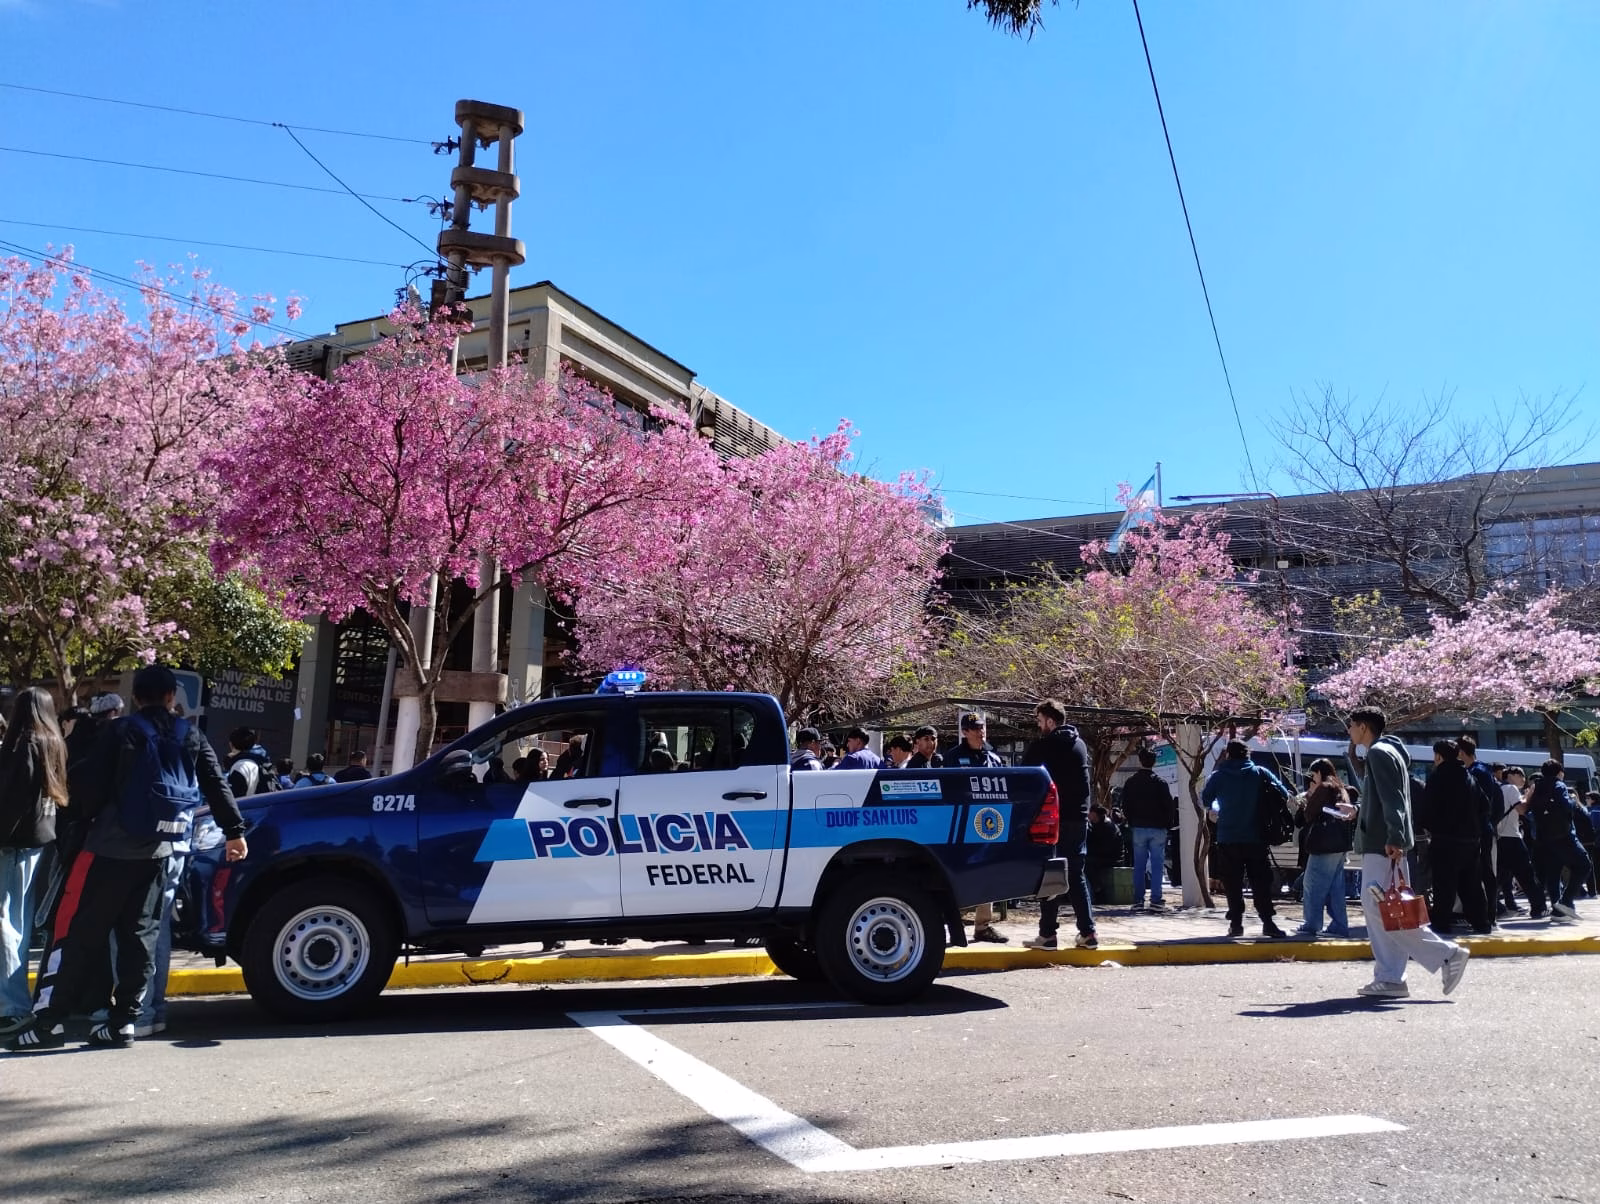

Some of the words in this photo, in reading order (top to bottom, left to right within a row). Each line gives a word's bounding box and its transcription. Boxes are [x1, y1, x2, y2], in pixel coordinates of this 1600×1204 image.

[212, 683, 273, 701] NACIONAL
[275, 691, 292, 703] DE
[210, 695, 236, 710] SAN
[238, 700, 265, 713] LUIS
[917, 781, 938, 792] 134
[981, 776, 1008, 792] 911
[372, 794, 416, 811] 8274
[825, 810, 860, 828] DUOF
[862, 809, 889, 826] SAN
[890, 808, 918, 825] LUIS
[527, 812, 751, 858] POLICIA
[646, 862, 755, 886] FEDERAL
